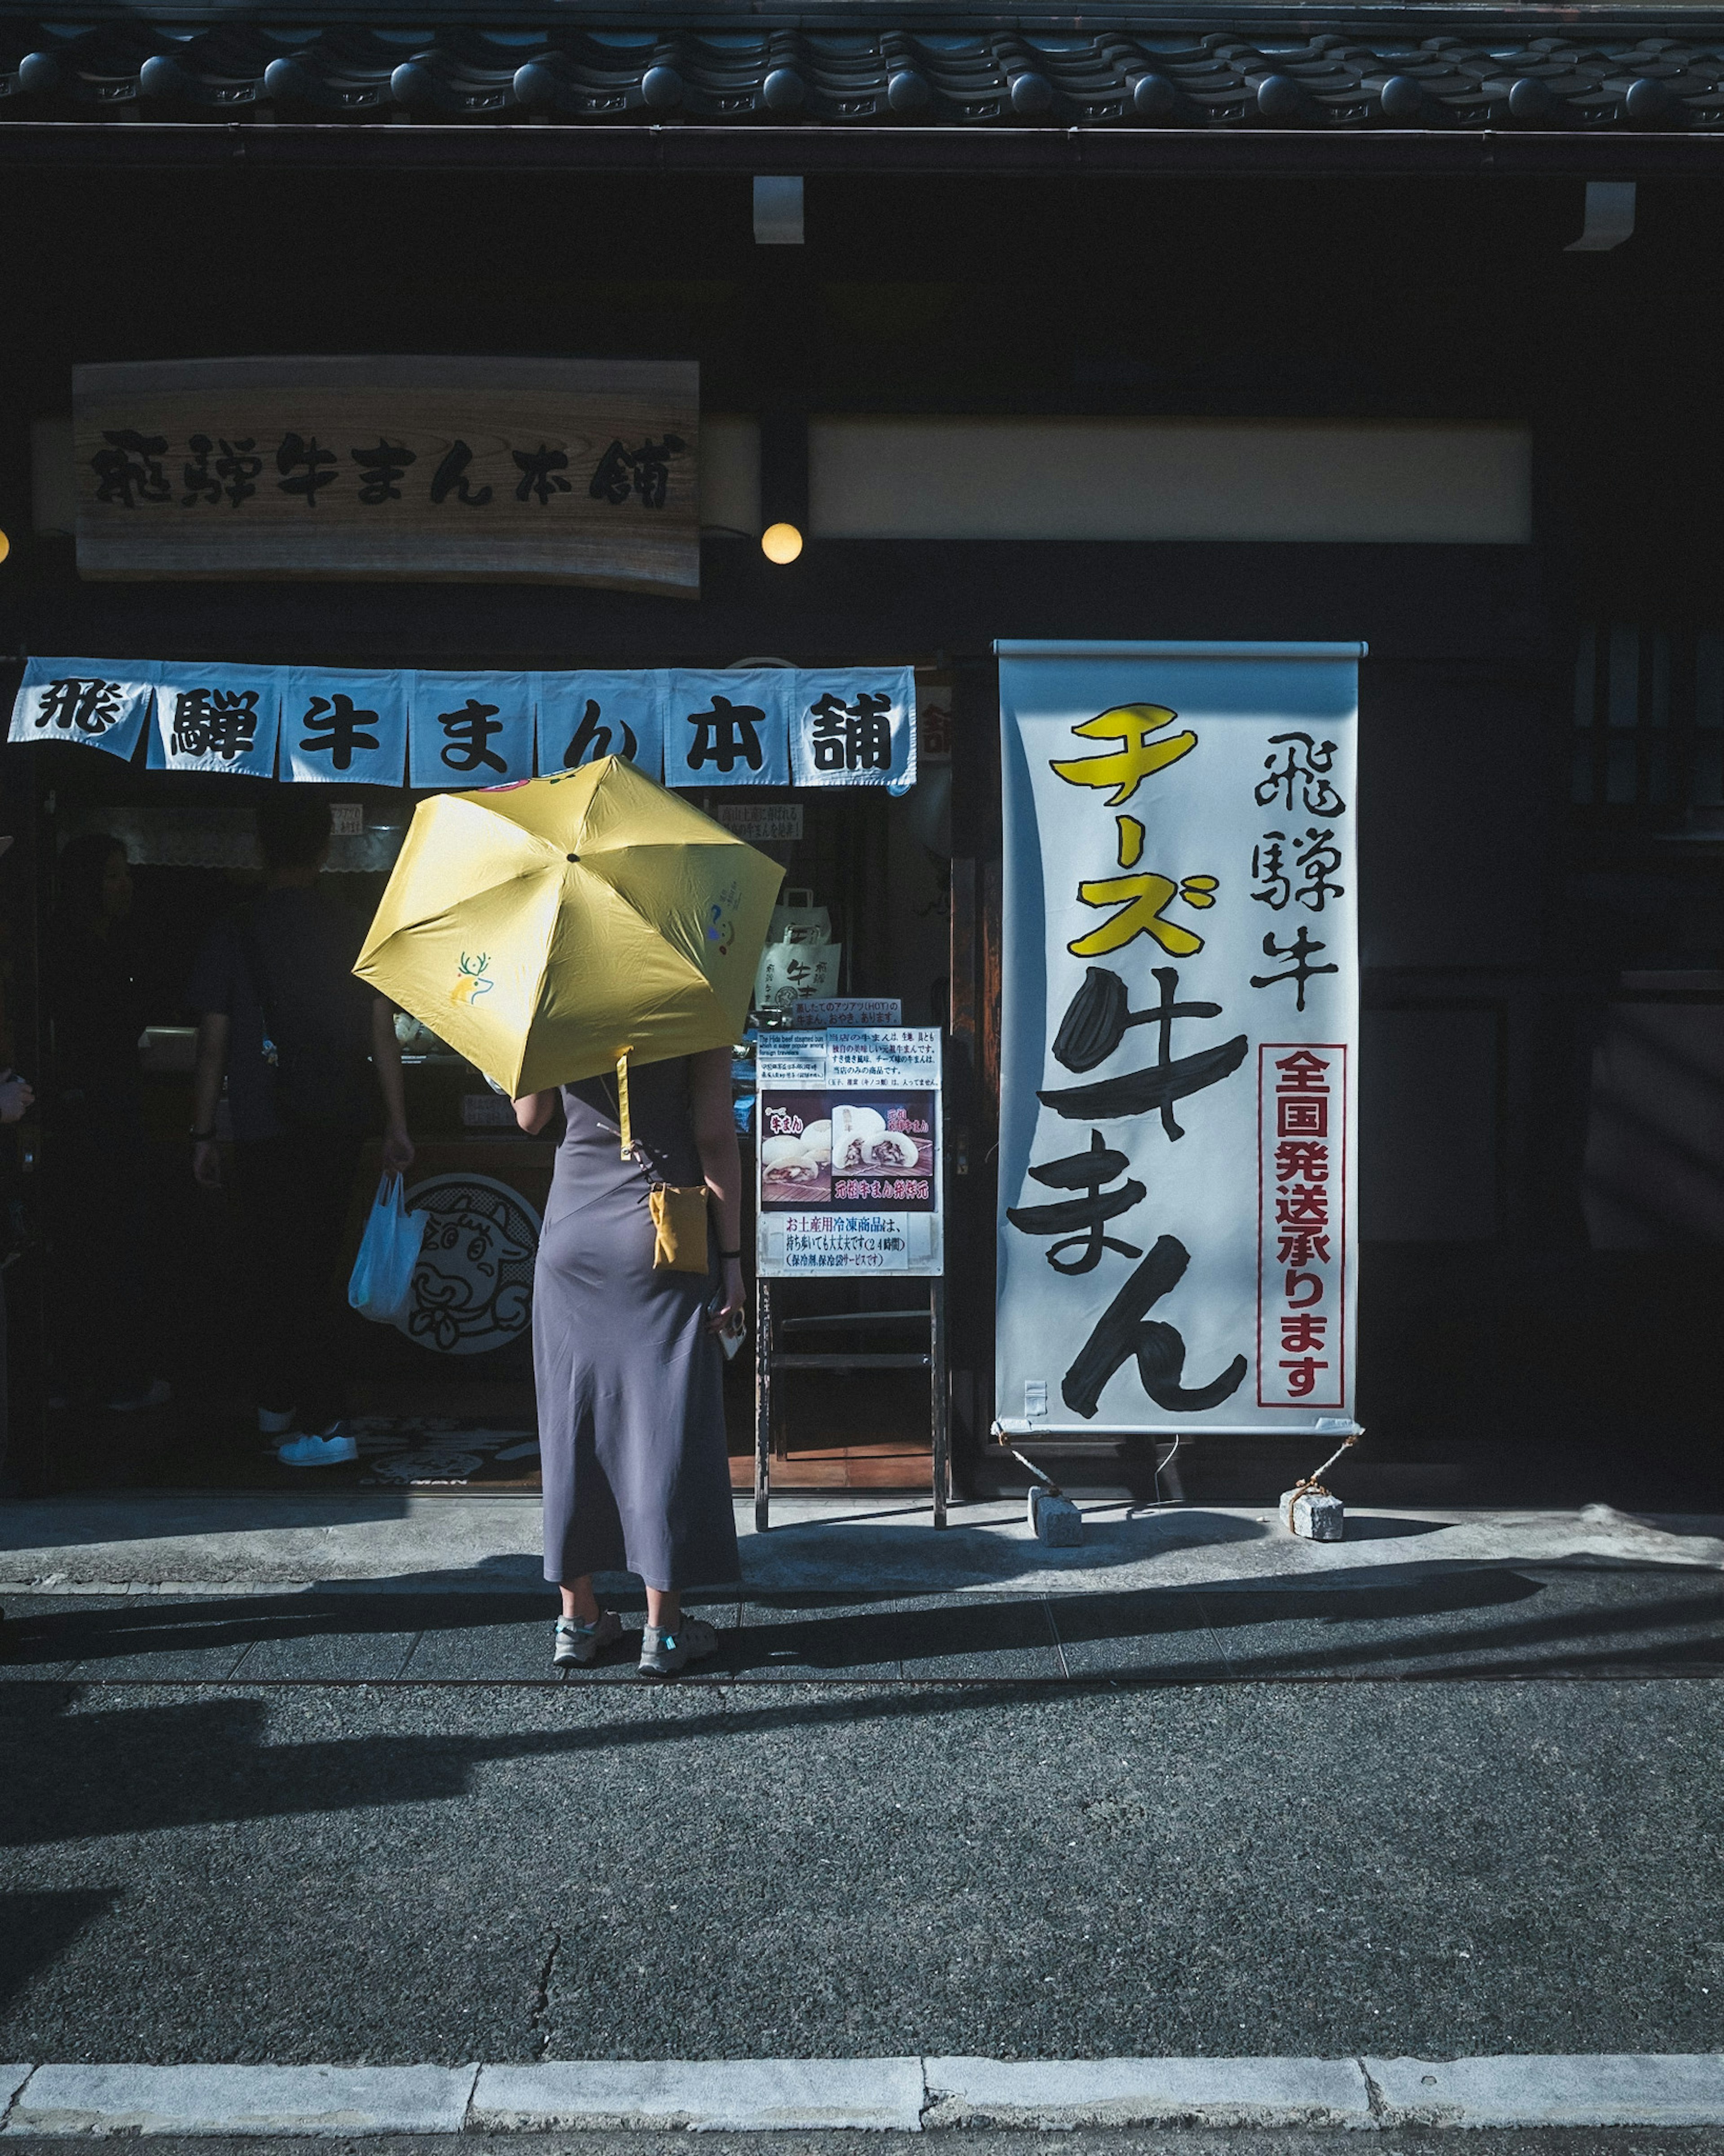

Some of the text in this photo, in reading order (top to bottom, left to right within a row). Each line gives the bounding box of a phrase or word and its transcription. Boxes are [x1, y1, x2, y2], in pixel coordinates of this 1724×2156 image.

[92, 429, 688, 507] 飛騨牛まん本舗
[35, 677, 893, 773] 飛騨牛まん本舗
[1249, 732, 1346, 1012] 飛騨牛
[833, 1066, 901, 1075] 当店のみの商品です。
[1006, 703, 1249, 1419] チーズ牛まん
[770, 1115, 804, 1134] 牛まん
[786, 1217, 901, 1233] お土産用冷凍商品は、
[1274, 1050, 1332, 1397] 全国発送承ります
